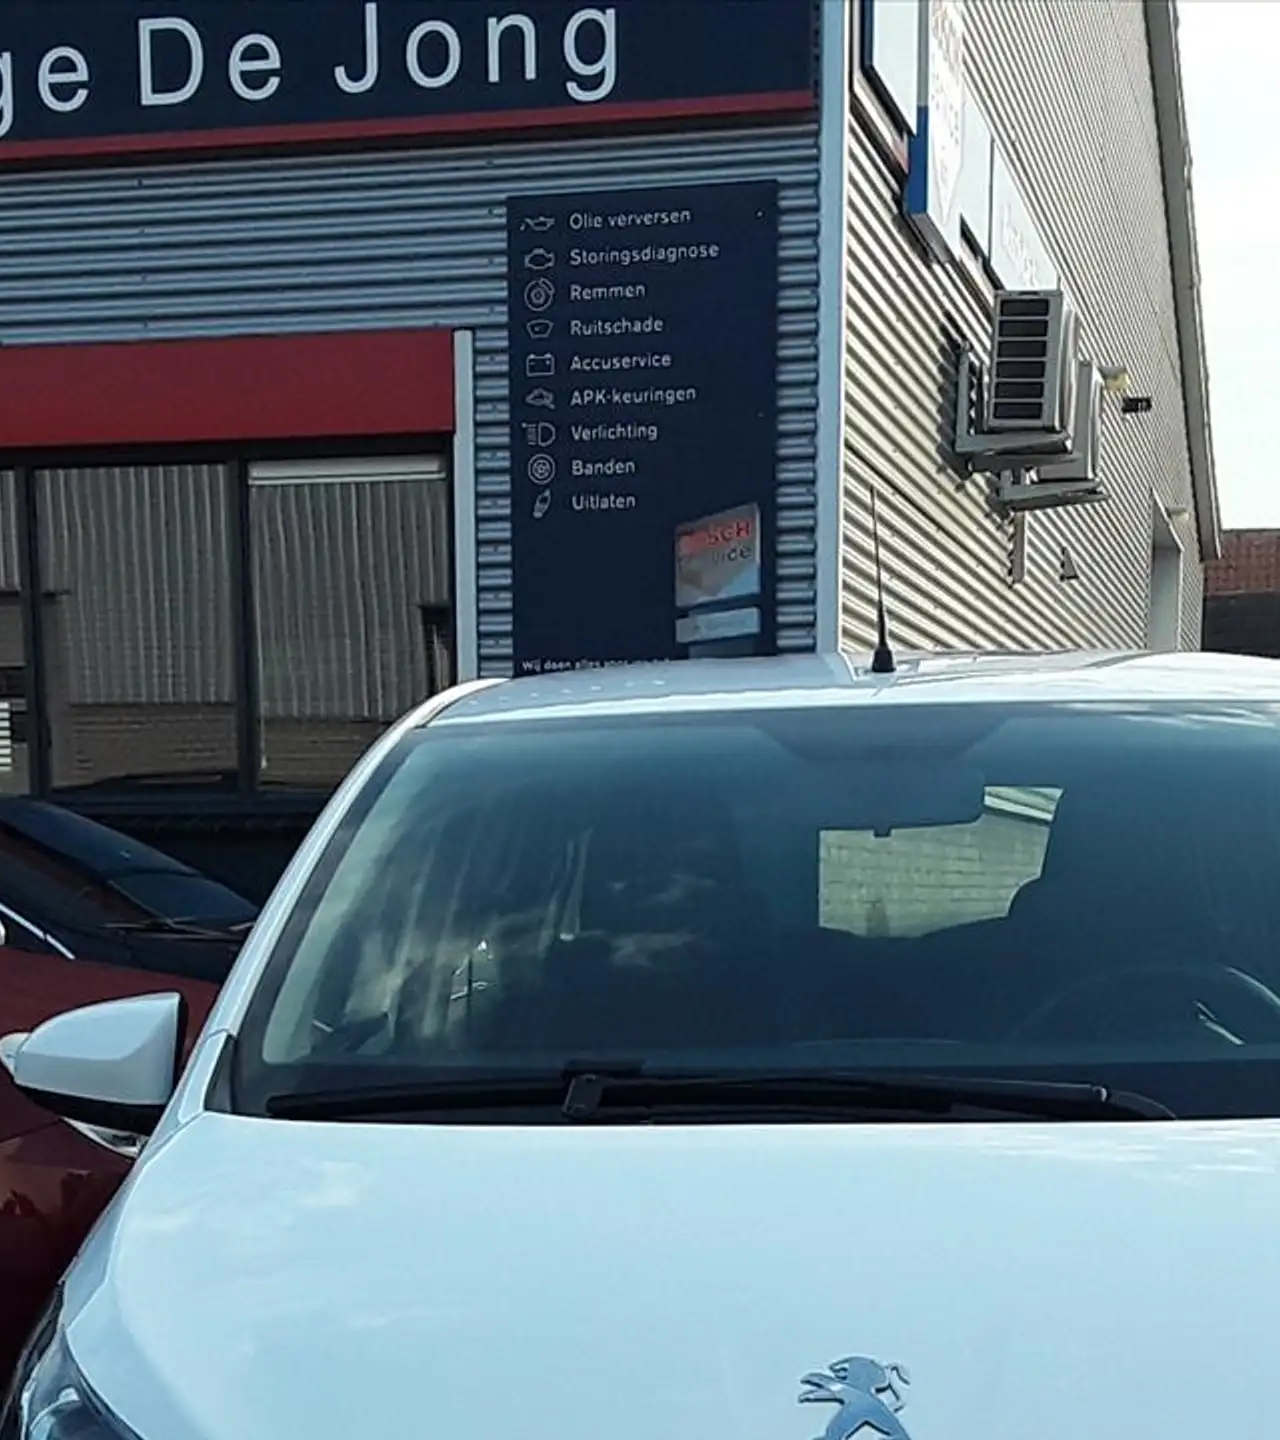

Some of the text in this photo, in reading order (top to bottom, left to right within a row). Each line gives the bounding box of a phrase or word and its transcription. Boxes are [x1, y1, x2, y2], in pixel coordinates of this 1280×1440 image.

[138, 17, 282, 105] De
[333, 3, 616, 102] Jong
[570, 210, 691, 229] Olie verversen
[570, 243, 720, 265] Storingsdiagnose
[571, 284, 646, 300] Remmen
[571, 317, 664, 335] Ruitschade
[571, 352, 672, 370] Accuservice
[571, 387, 697, 406] APK-keuringen
[571, 423, 658, 441] Verlichting
[572, 457, 636, 475] Banden
[572, 494, 636, 511] Uitlaten
